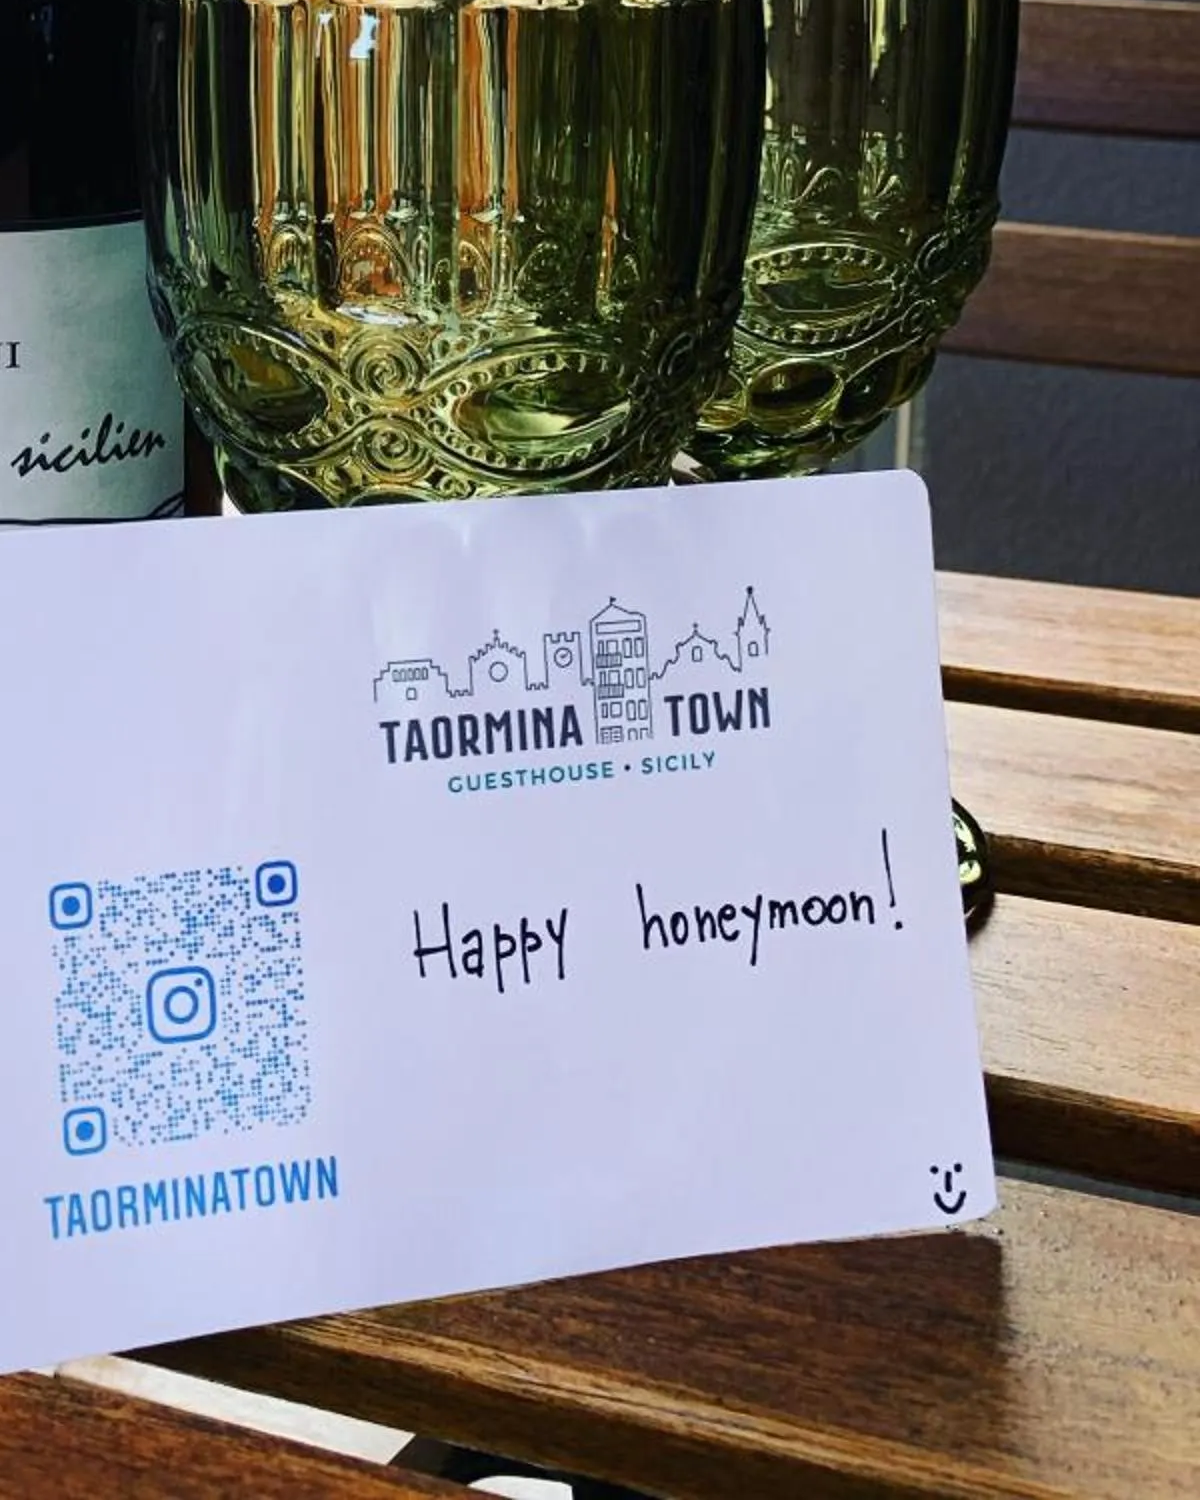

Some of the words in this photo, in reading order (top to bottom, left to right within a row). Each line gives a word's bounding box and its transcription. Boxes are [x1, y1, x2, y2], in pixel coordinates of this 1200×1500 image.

[10, 412, 166, 477] sicilien
[379, 704, 583, 764] TAORMINA
[664, 687, 771, 737] TOWN
[448, 761, 614, 793] GUESTHOUSE
[642, 750, 716, 774] SICILY
[413, 902, 568, 993] Happy
[636, 828, 903, 967] honeymoon!
[43, 1156, 338, 1239] TAORMINATOWN
